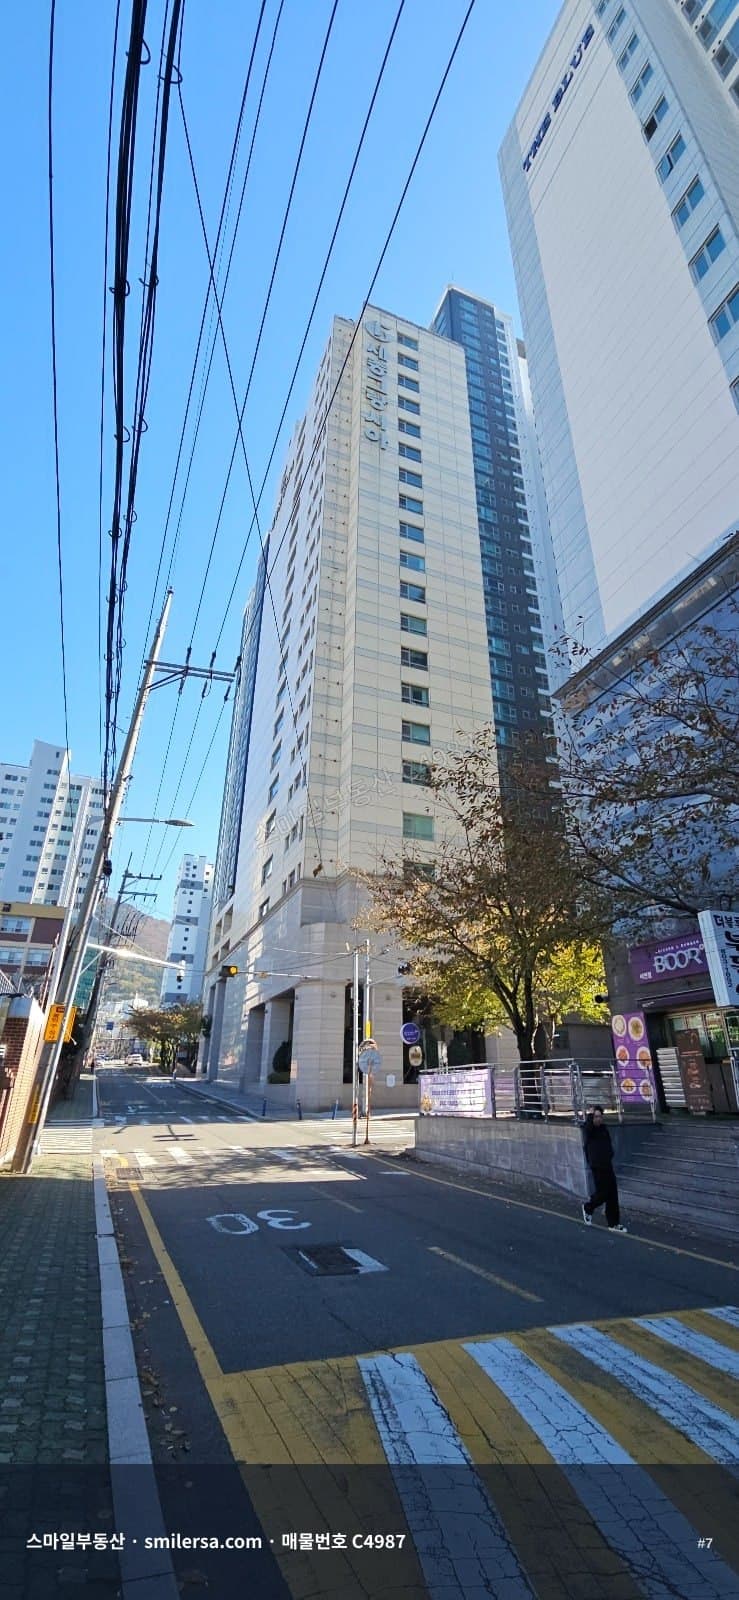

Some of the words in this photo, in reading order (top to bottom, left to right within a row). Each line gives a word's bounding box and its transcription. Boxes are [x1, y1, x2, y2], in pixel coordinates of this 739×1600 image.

[523, 112, 551, 172] THE
[552, 23, 595, 113] BLUE
[204, 1209, 312, 1236] 30
